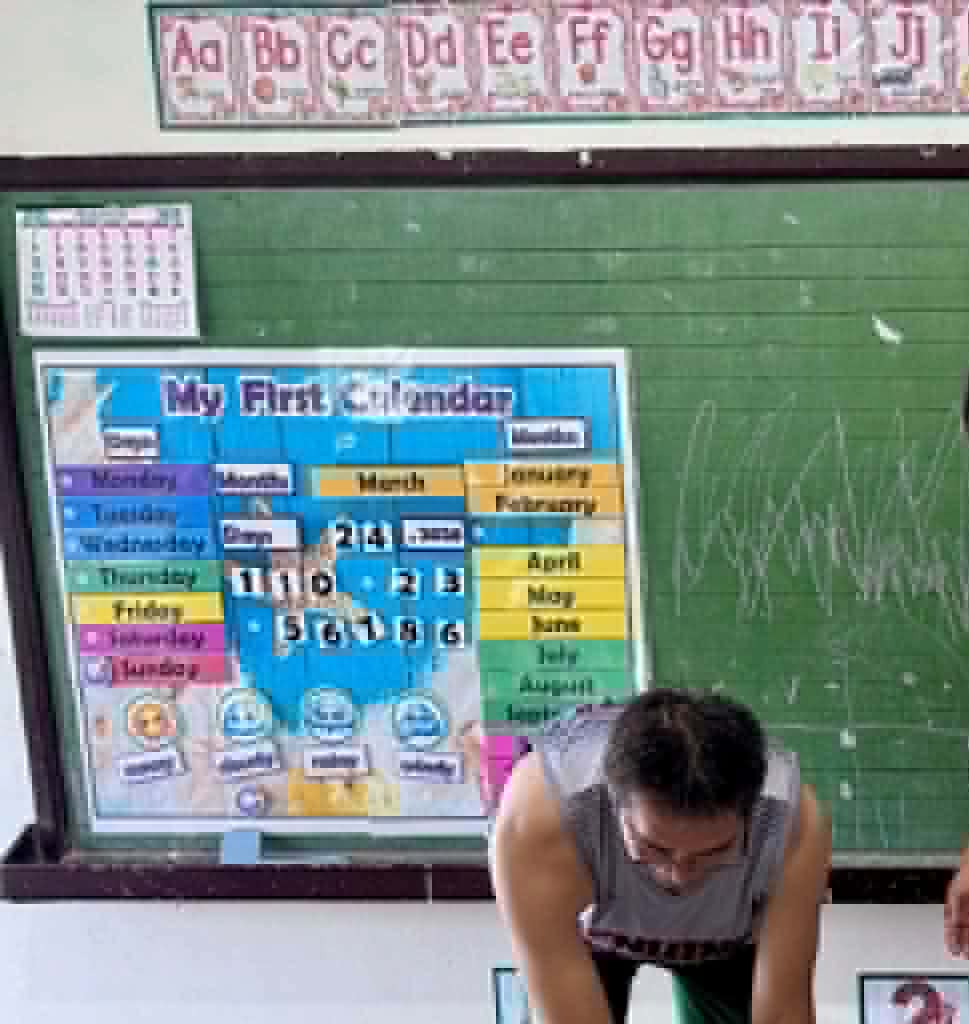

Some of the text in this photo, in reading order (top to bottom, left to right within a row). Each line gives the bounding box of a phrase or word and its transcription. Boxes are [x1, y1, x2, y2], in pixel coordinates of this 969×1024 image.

[173, 26, 224, 72] Aa
[255, 23, 299, 70] Bb
[327, 25, 377, 70] Cc
[401, 20, 456, 66] Dd
[486, 19, 533, 65] Ee
[571, 17, 609, 64] Ff
[643, 14, 692, 74] Gg
[722, 12, 769, 61] Hh
[815, 12, 840, 60] Ii
[892, 12, 926, 67] Jj
[168, 381, 223, 416] My
[241, 381, 322, 413] First
[91, 470, 178, 493] Monday
[358, 471, 426, 492] March
[504, 465, 591, 488] January
[93, 503, 177, 527] Tuesday
[496, 493, 596, 517] February
[80, 532, 207, 555] Wednesday
[527, 551, 583, 574] April
[98, 566, 200, 588] Thursday
[527, 584, 575, 610] May
[112, 599, 184, 623] Friday
[530, 614, 582, 635] June
[110, 628, 209, 650] Saturday
[536, 644, 579, 668] July
[118, 657, 201, 681] Sunday
[518, 674, 595, 696] August
